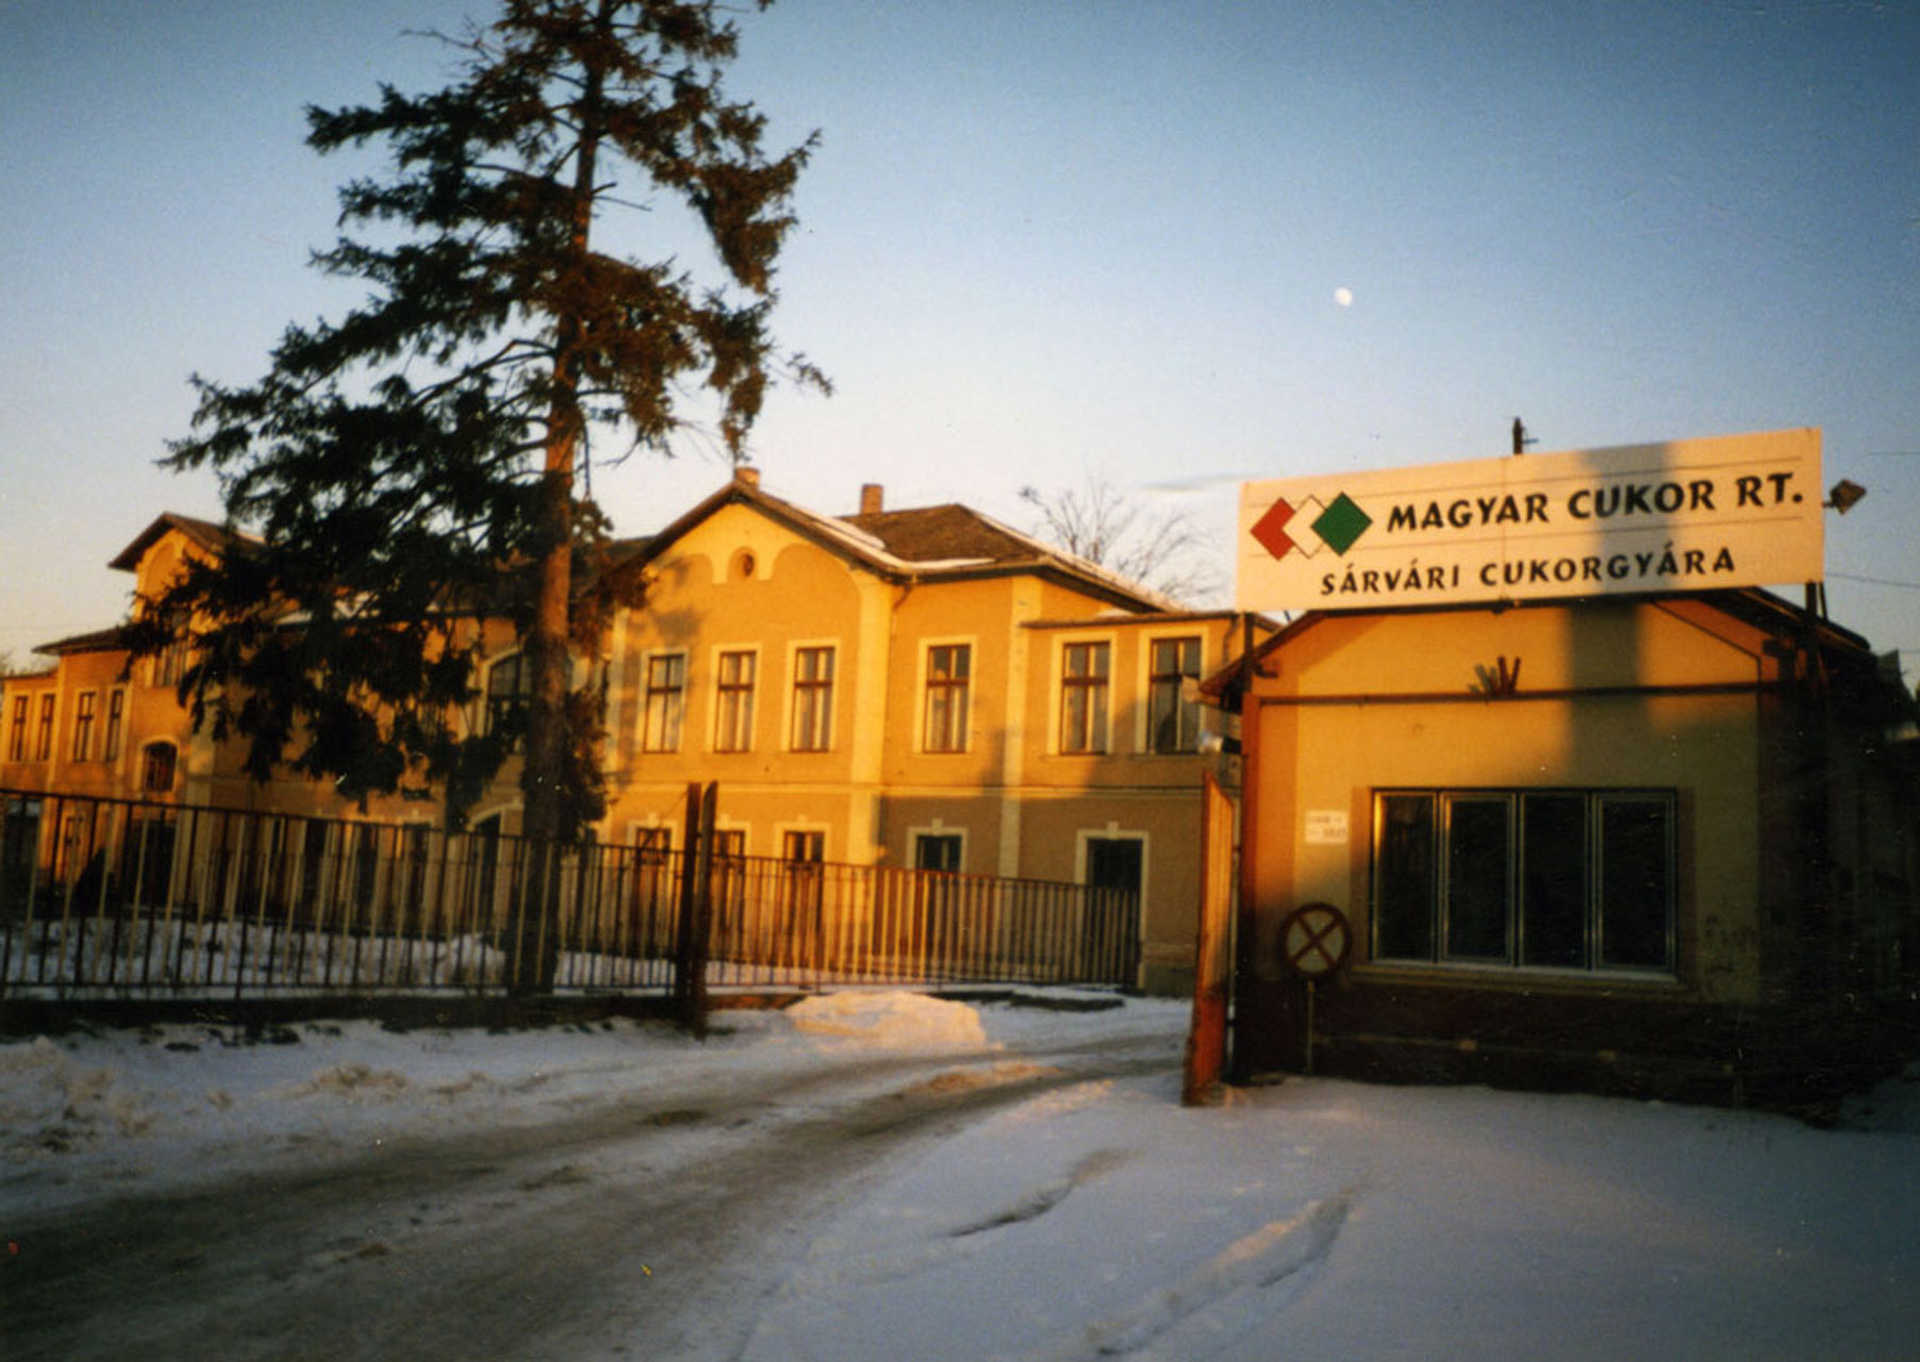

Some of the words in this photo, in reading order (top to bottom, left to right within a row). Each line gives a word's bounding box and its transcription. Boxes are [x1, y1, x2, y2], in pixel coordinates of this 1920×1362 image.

[1386, 491, 1550, 533] MAGYAR
[1567, 478, 1715, 519] CUKOR
[1736, 472, 1804, 508] RT.
[1320, 558, 1460, 596] SÁRVÁRI
[1479, 541, 1736, 587] CUKORGYÁRA
